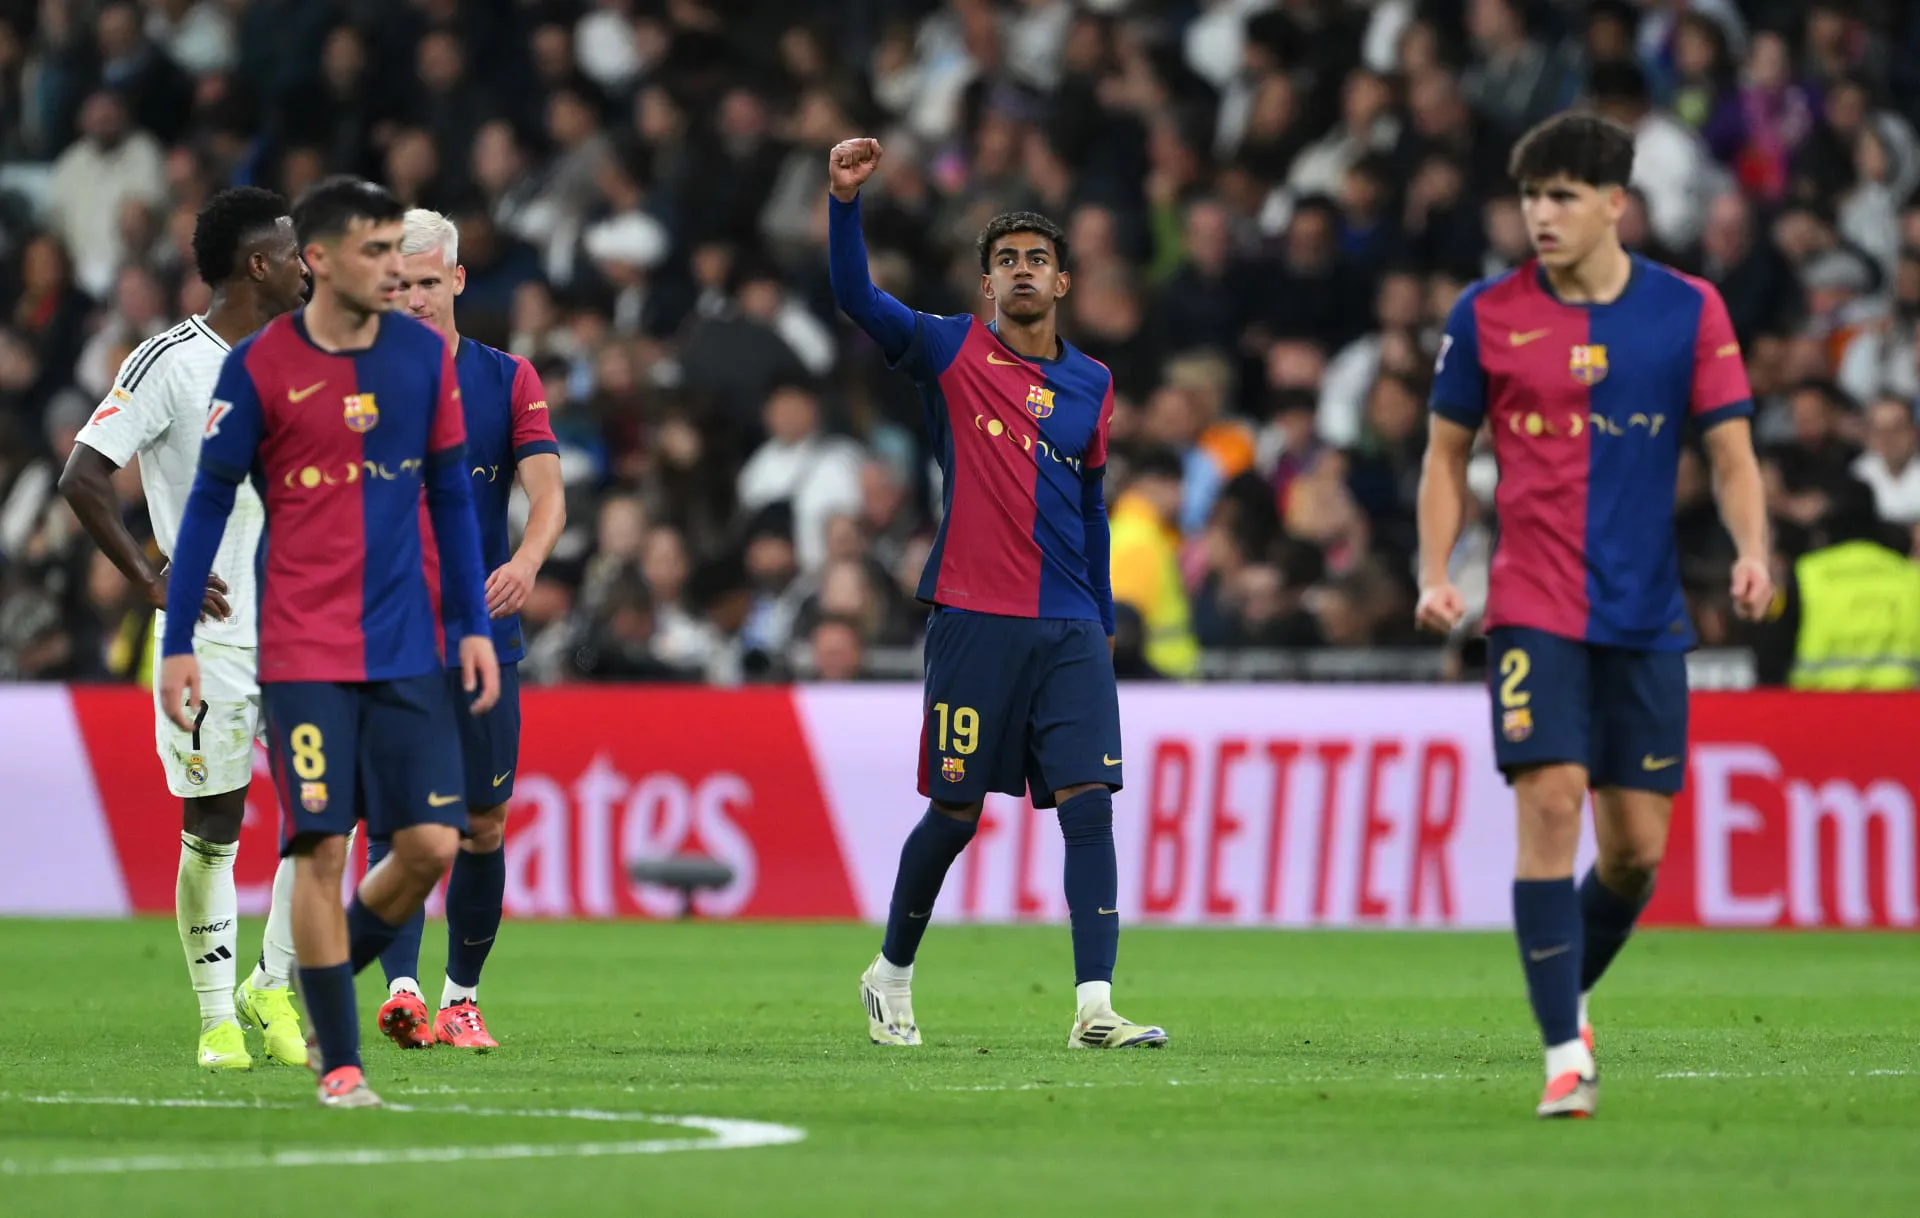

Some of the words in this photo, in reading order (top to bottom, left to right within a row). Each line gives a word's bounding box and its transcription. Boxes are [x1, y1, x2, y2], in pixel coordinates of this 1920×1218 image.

[1501, 648, 1531, 708] 2
[184, 699, 209, 751] 7
[290, 722, 327, 780] 8
[933, 702, 980, 755] 19
[1140, 738, 1464, 917] BETTER
[1692, 742, 1918, 928] Em
[190, 919, 231, 935] RMCF
